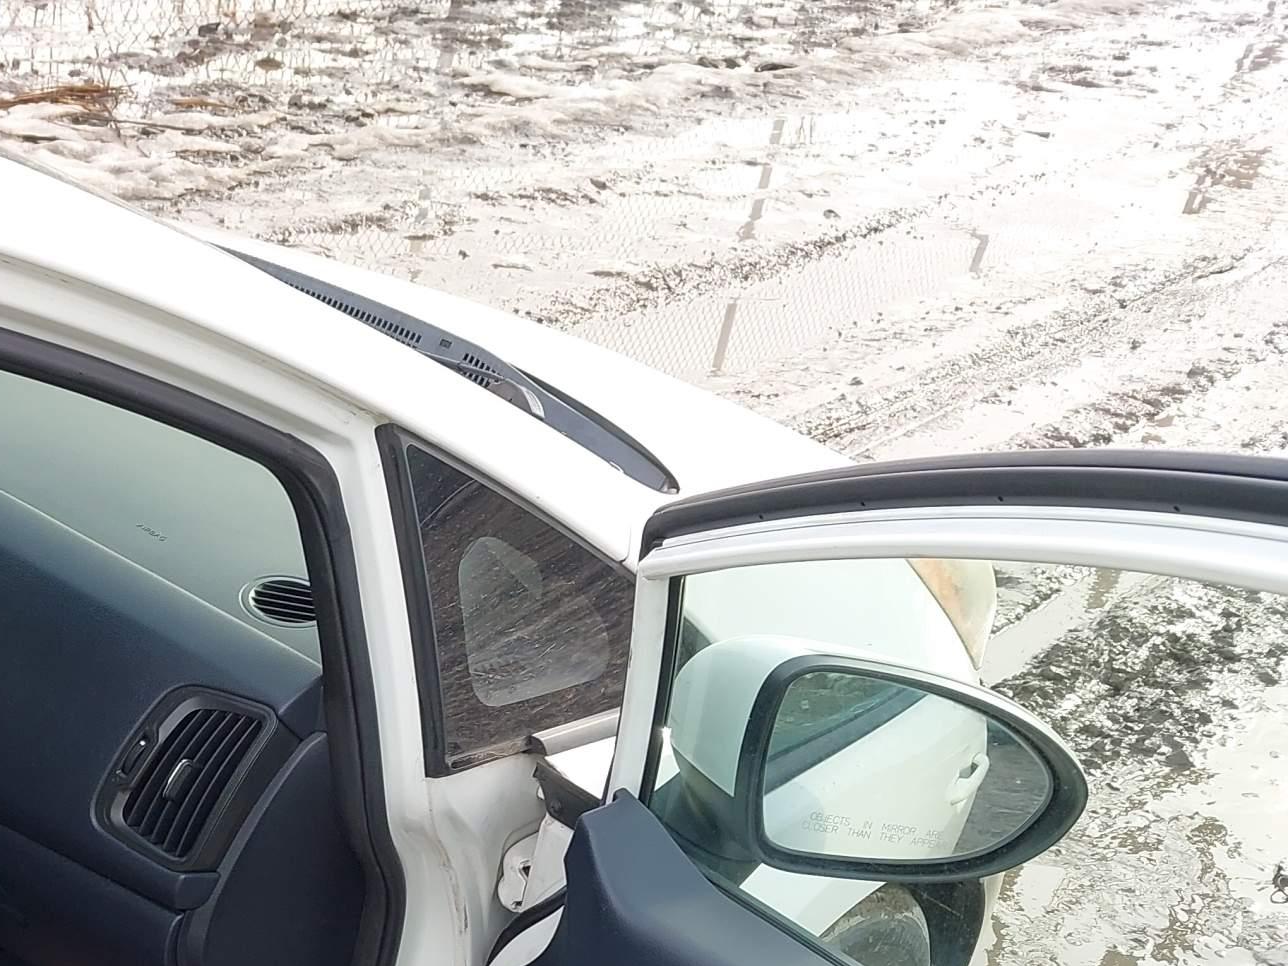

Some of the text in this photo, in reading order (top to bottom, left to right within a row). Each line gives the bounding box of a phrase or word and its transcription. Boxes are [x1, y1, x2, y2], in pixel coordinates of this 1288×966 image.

[135, 524, 169, 541] AIRBAG
[801, 819, 840, 833] CLOSER
[847, 827, 872, 840] THAN
[879, 831, 904, 843] THEY
[809, 811, 945, 840] OBJECTS IN MIRROR ARE
